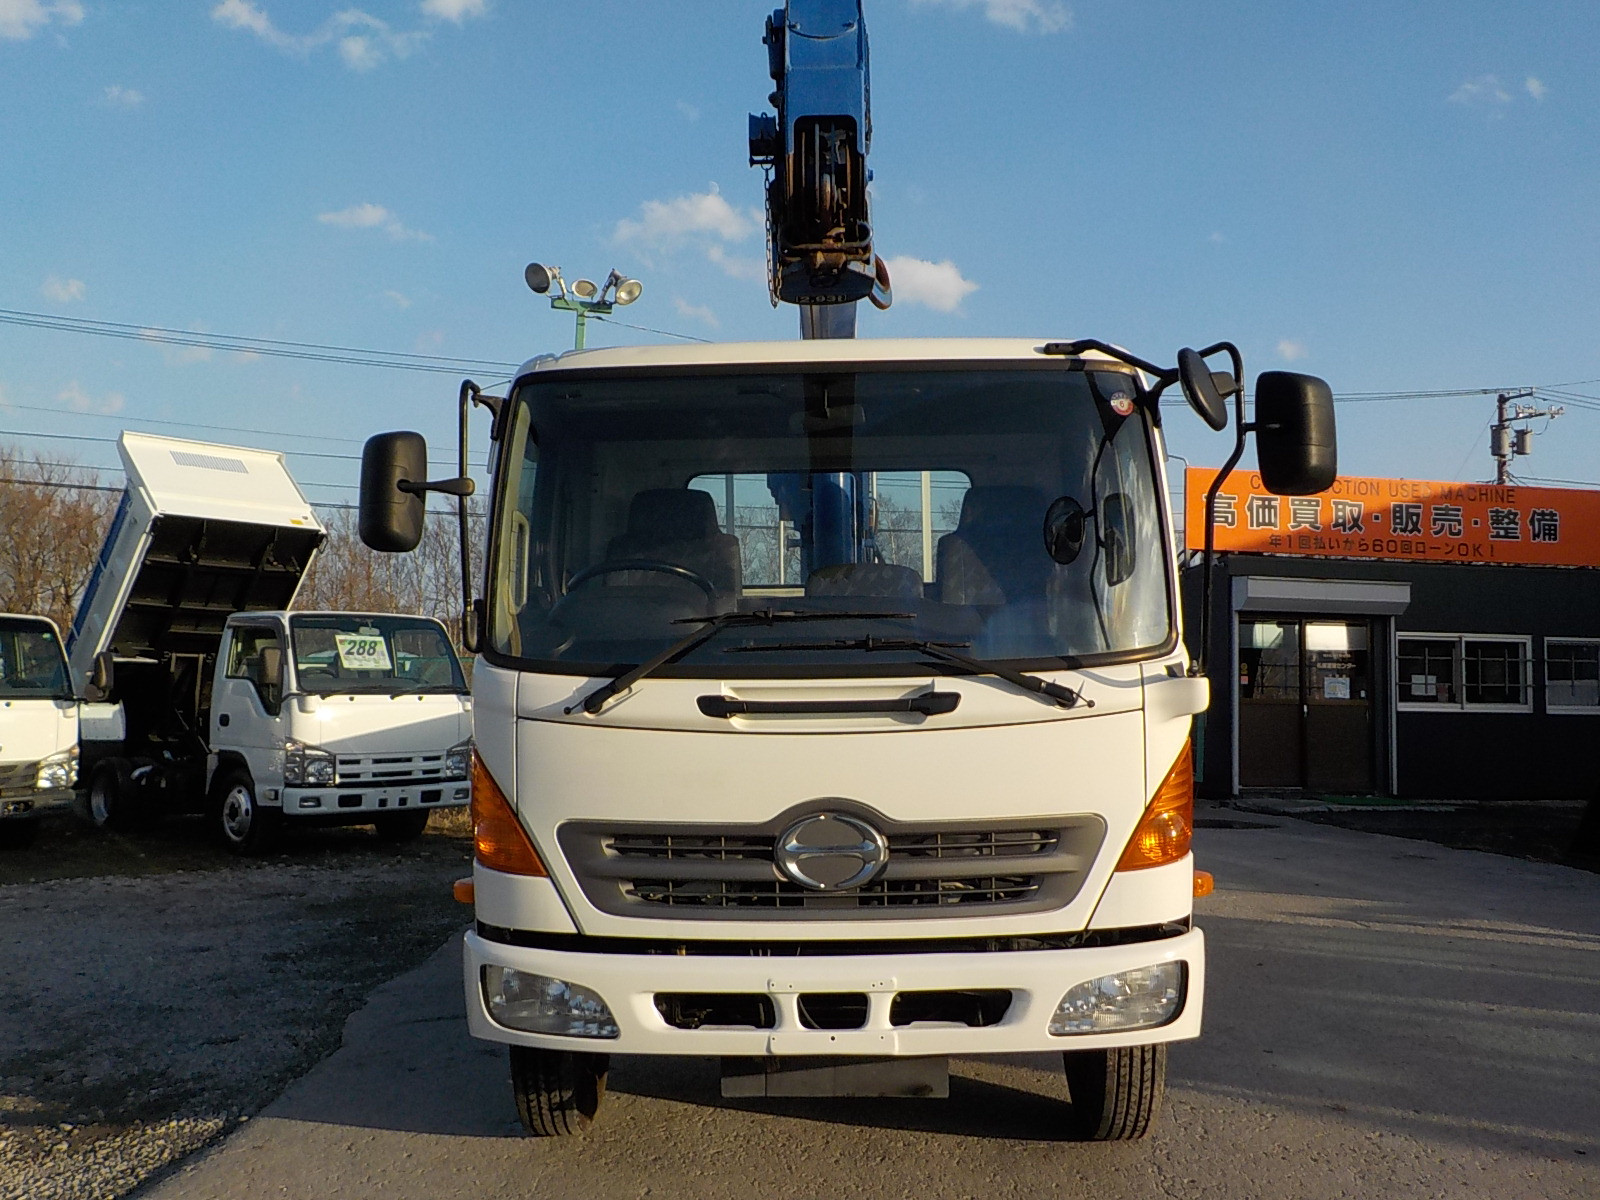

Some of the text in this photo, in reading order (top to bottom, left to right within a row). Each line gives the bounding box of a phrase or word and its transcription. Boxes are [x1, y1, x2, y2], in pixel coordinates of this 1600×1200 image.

[1250, 474, 1515, 504] CCTION USED MACHINE
[344, 639, 378, 656] 288
